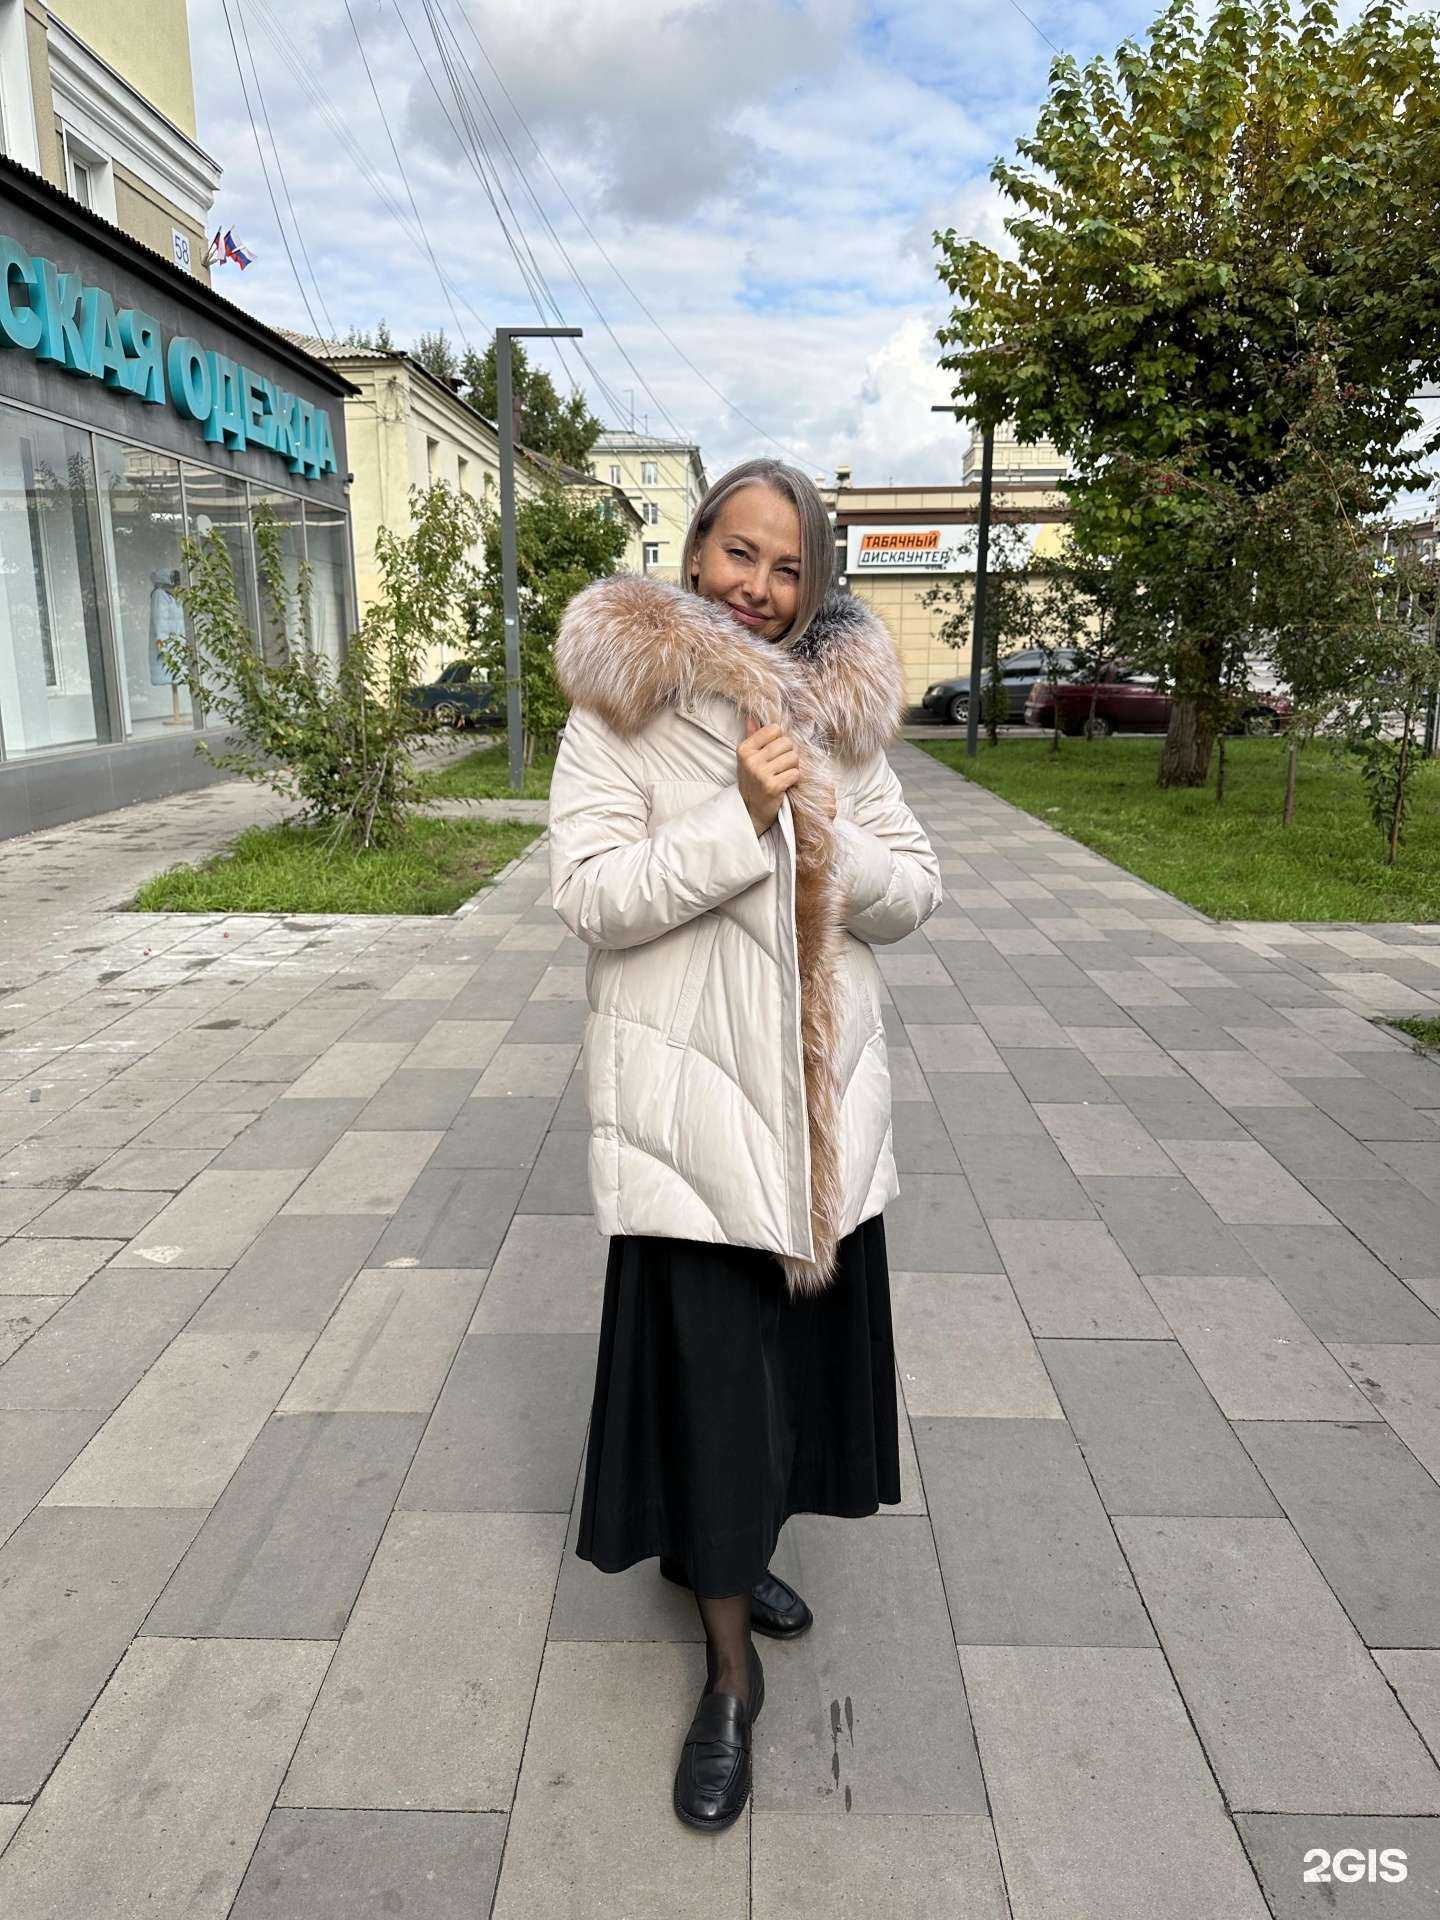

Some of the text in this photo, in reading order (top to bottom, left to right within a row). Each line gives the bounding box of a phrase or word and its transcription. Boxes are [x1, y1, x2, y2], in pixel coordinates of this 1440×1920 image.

[175, 235, 189, 264] 58
[168, 336, 338, 481] ОДЕЖДА
[866, 532, 938, 548] ТАБАЧНЫЙ
[861, 551, 949, 563] ДИСКАУНТЕР
